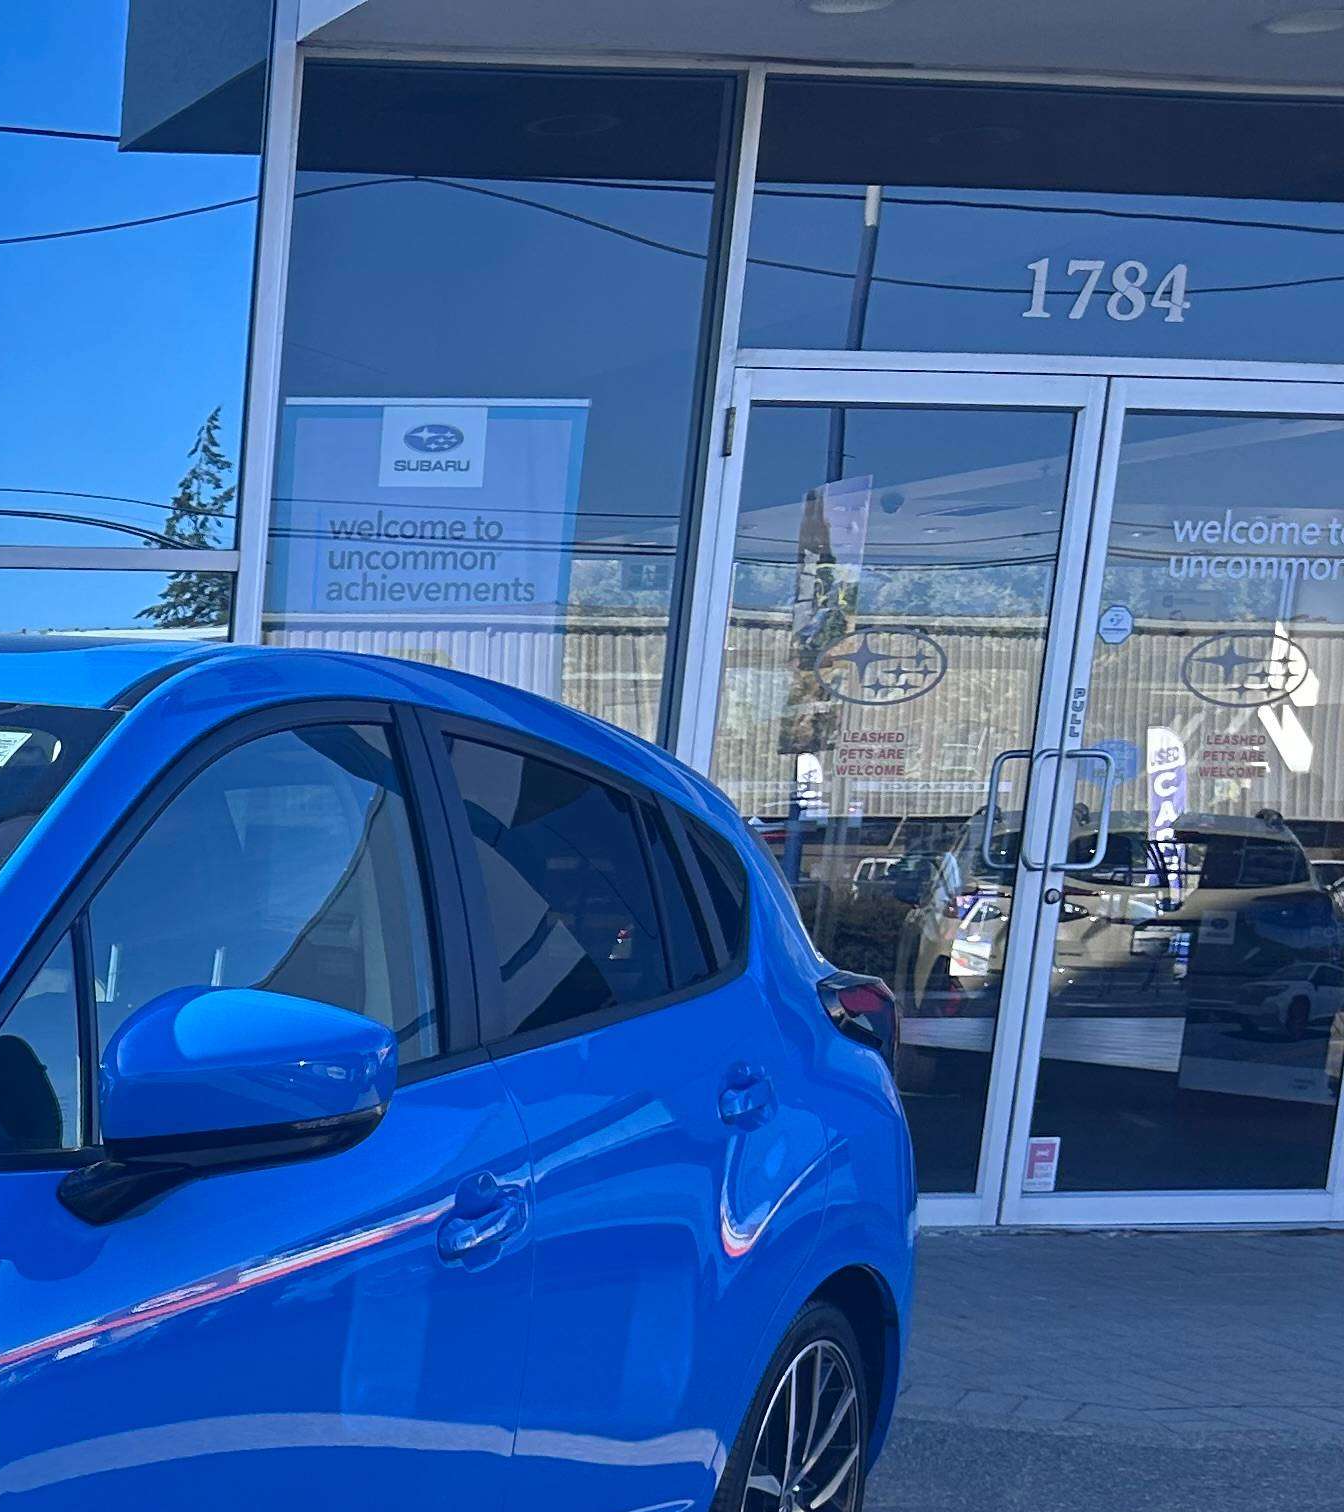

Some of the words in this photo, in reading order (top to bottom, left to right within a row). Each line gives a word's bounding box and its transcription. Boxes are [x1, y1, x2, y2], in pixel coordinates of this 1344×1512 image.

[1022, 258, 1191, 323] 1784
[393, 459, 470, 472] SUBARU
[329, 510, 466, 540] welcome
[473, 515, 503, 540] to
[1173, 508, 1321, 545] welcome
[1328, 517, 1344, 546] t
[328, 550, 496, 571] uncommon
[326, 572, 536, 603] achievements
[1068, 687, 1086, 738] PULL
[843, 732, 905, 743] LEASHED
[1206, 734, 1266, 746] LEASHED
[839, 748, 874, 760] PETS
[878, 748, 905, 760] ARE
[1203, 750, 1236, 761] PETS
[1240, 750, 1266, 762] ARE
[835, 765, 905, 776] WELCOME
[1199, 766, 1266, 778] WELCOME
